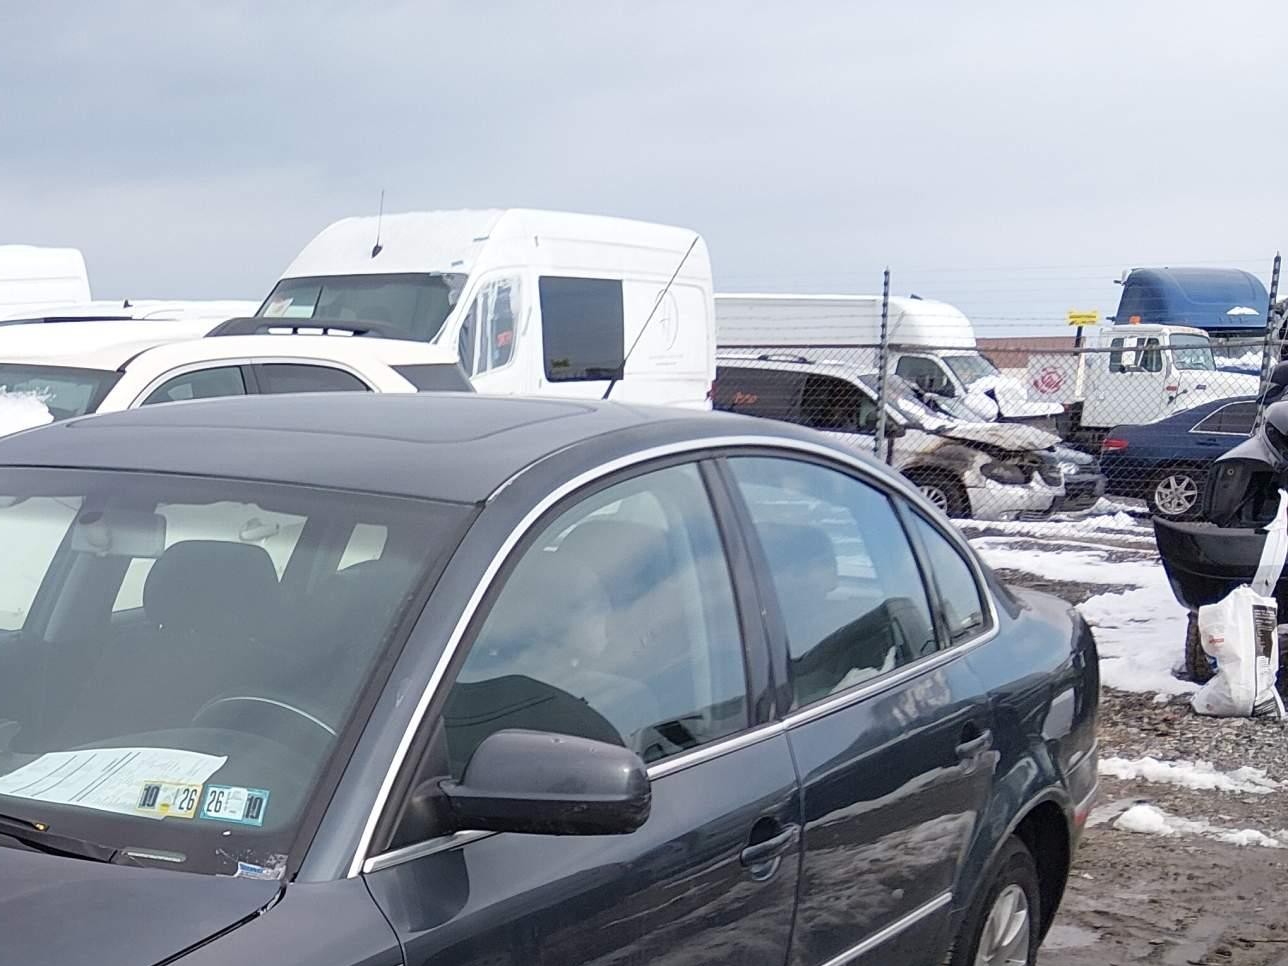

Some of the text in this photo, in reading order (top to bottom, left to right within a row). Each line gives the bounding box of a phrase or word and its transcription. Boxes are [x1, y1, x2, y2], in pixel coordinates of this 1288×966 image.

[139, 784, 198, 812] 10 26
[206, 790, 264, 820] 26 10
